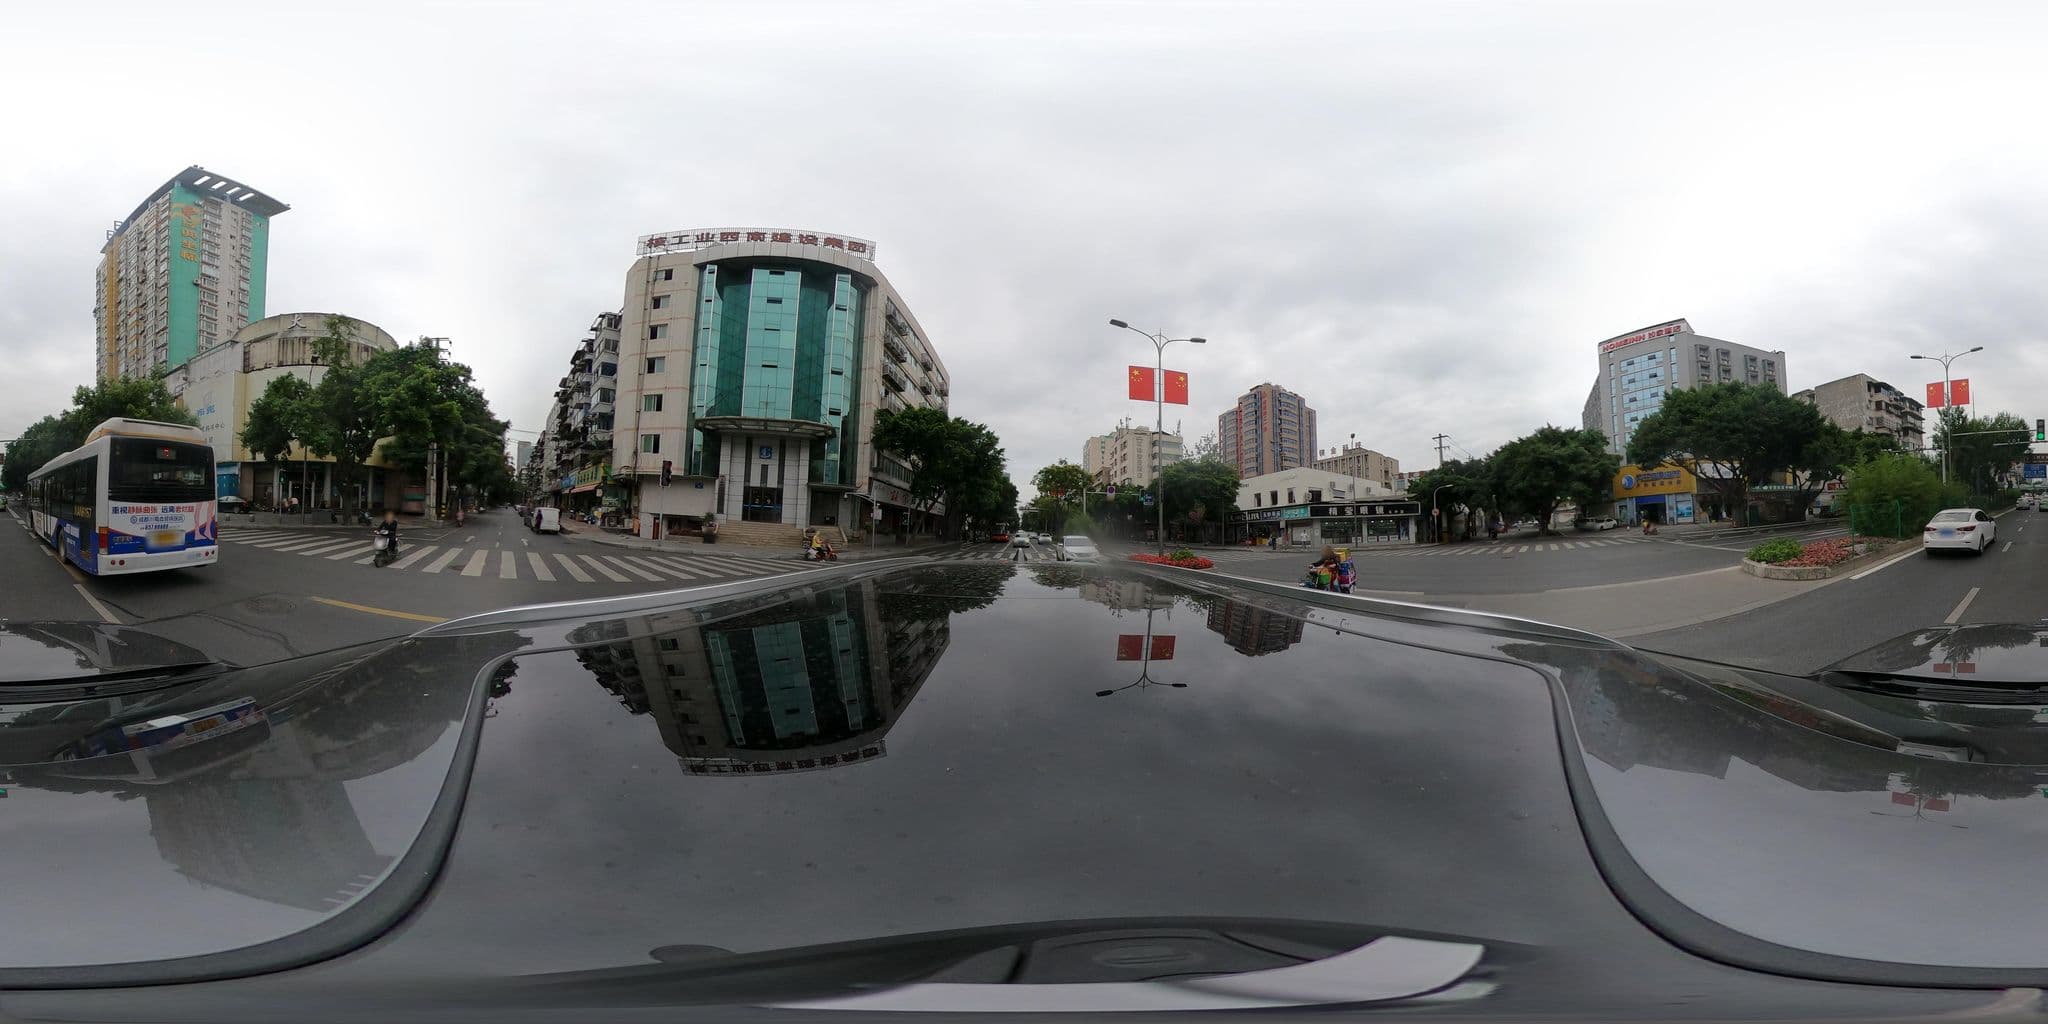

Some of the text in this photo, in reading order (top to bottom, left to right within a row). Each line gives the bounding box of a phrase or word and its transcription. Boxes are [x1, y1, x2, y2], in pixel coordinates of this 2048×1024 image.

[646, 231, 867, 253] 核工业西南建设集团
